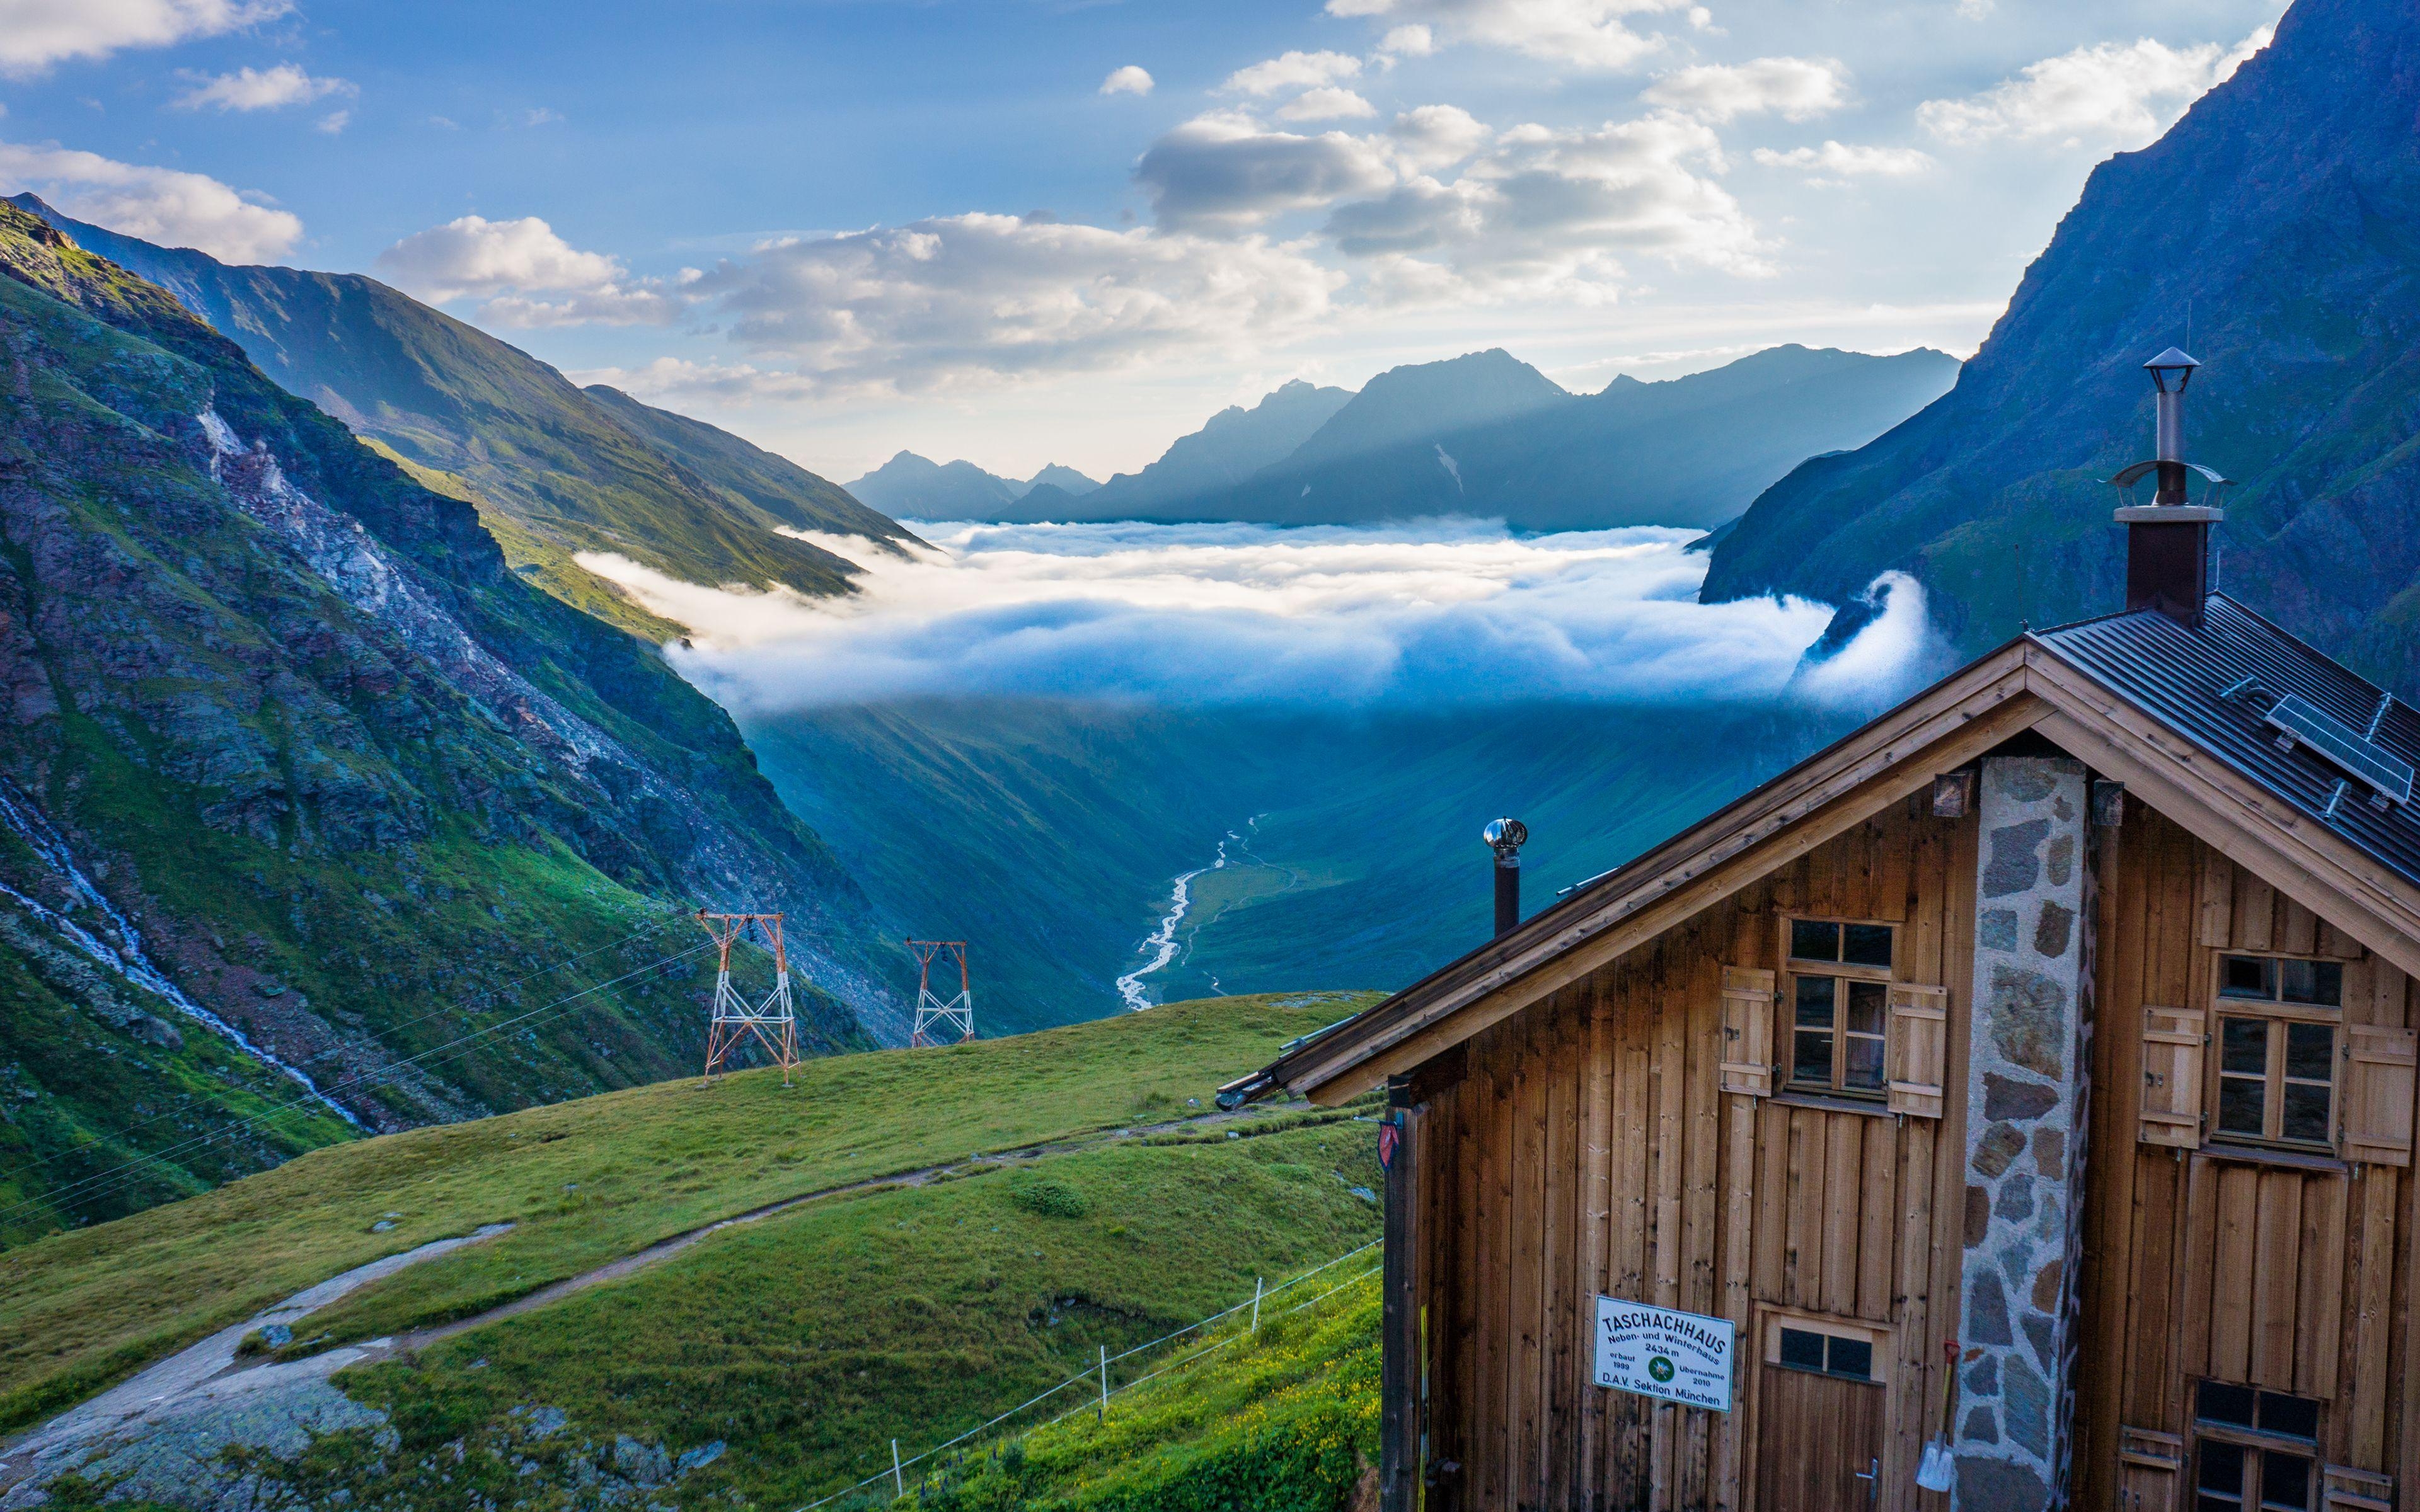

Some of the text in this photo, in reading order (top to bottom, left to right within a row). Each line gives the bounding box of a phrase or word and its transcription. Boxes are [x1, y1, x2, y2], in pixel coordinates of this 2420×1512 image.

[1603, 1312, 1726, 1354] TASCHACHHAUS
[1608, 1332, 1720, 1365] Neben- und Winterhaus
[1645, 1343, 1669, 1355] 2434
[1610, 1352, 1635, 1362] erbaut
[1613, 1361, 1630, 1370] 1999
[1693, 1378, 1710, 1387] 2010
[1603, 1372, 1720, 1406] D.A.V. Sektion München
